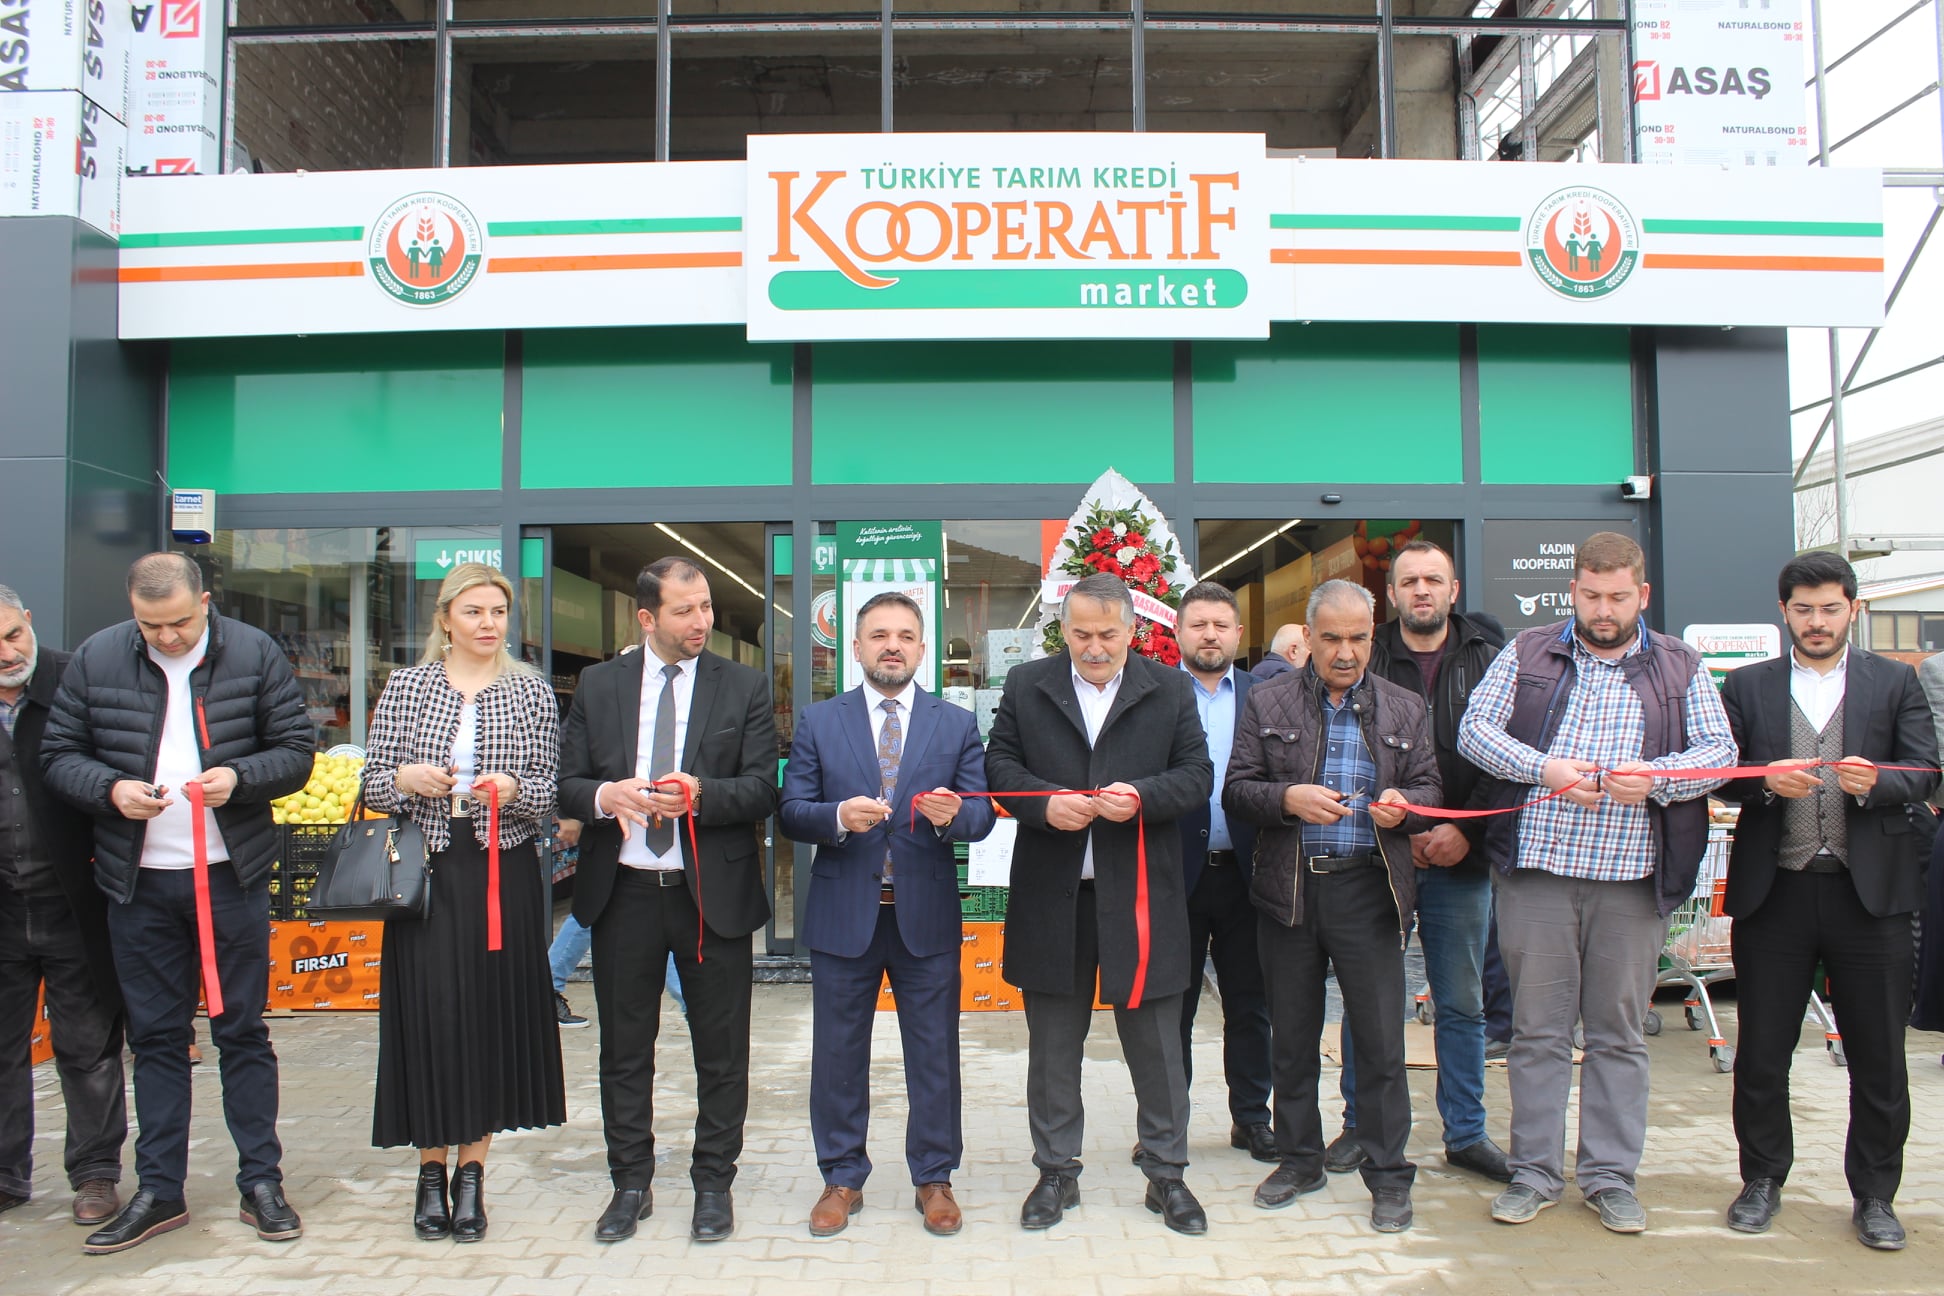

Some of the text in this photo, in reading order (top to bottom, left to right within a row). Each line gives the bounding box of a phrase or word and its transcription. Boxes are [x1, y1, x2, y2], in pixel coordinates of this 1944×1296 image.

[64, 0, 73, 35] NATUR
[1718, 22, 1791, 30] NATURALBOND
[0, 0, 29, 90] ASA
[1667, 66, 1771, 99] ASAŞ
[1722, 126, 1795, 135] NATURALBOND
[32, 131, 42, 210] NATURALBOND
[861, 161, 1176, 189] TÜRKİYE TARIM KREDİ
[768, 170, 1239, 289] KOOPERATİF
[414, 290, 436, 299] 1863
[1080, 275, 1216, 306] market
[1573, 284, 1595, 293] 1863
[815, 546, 837, 570] ÇI
[1539, 543, 1575, 555] KADIN
[1512, 556, 1576, 570] KOOPERATİ
[1541, 592, 1557, 607] ET
[295, 953, 348, 974] FIRSAT
